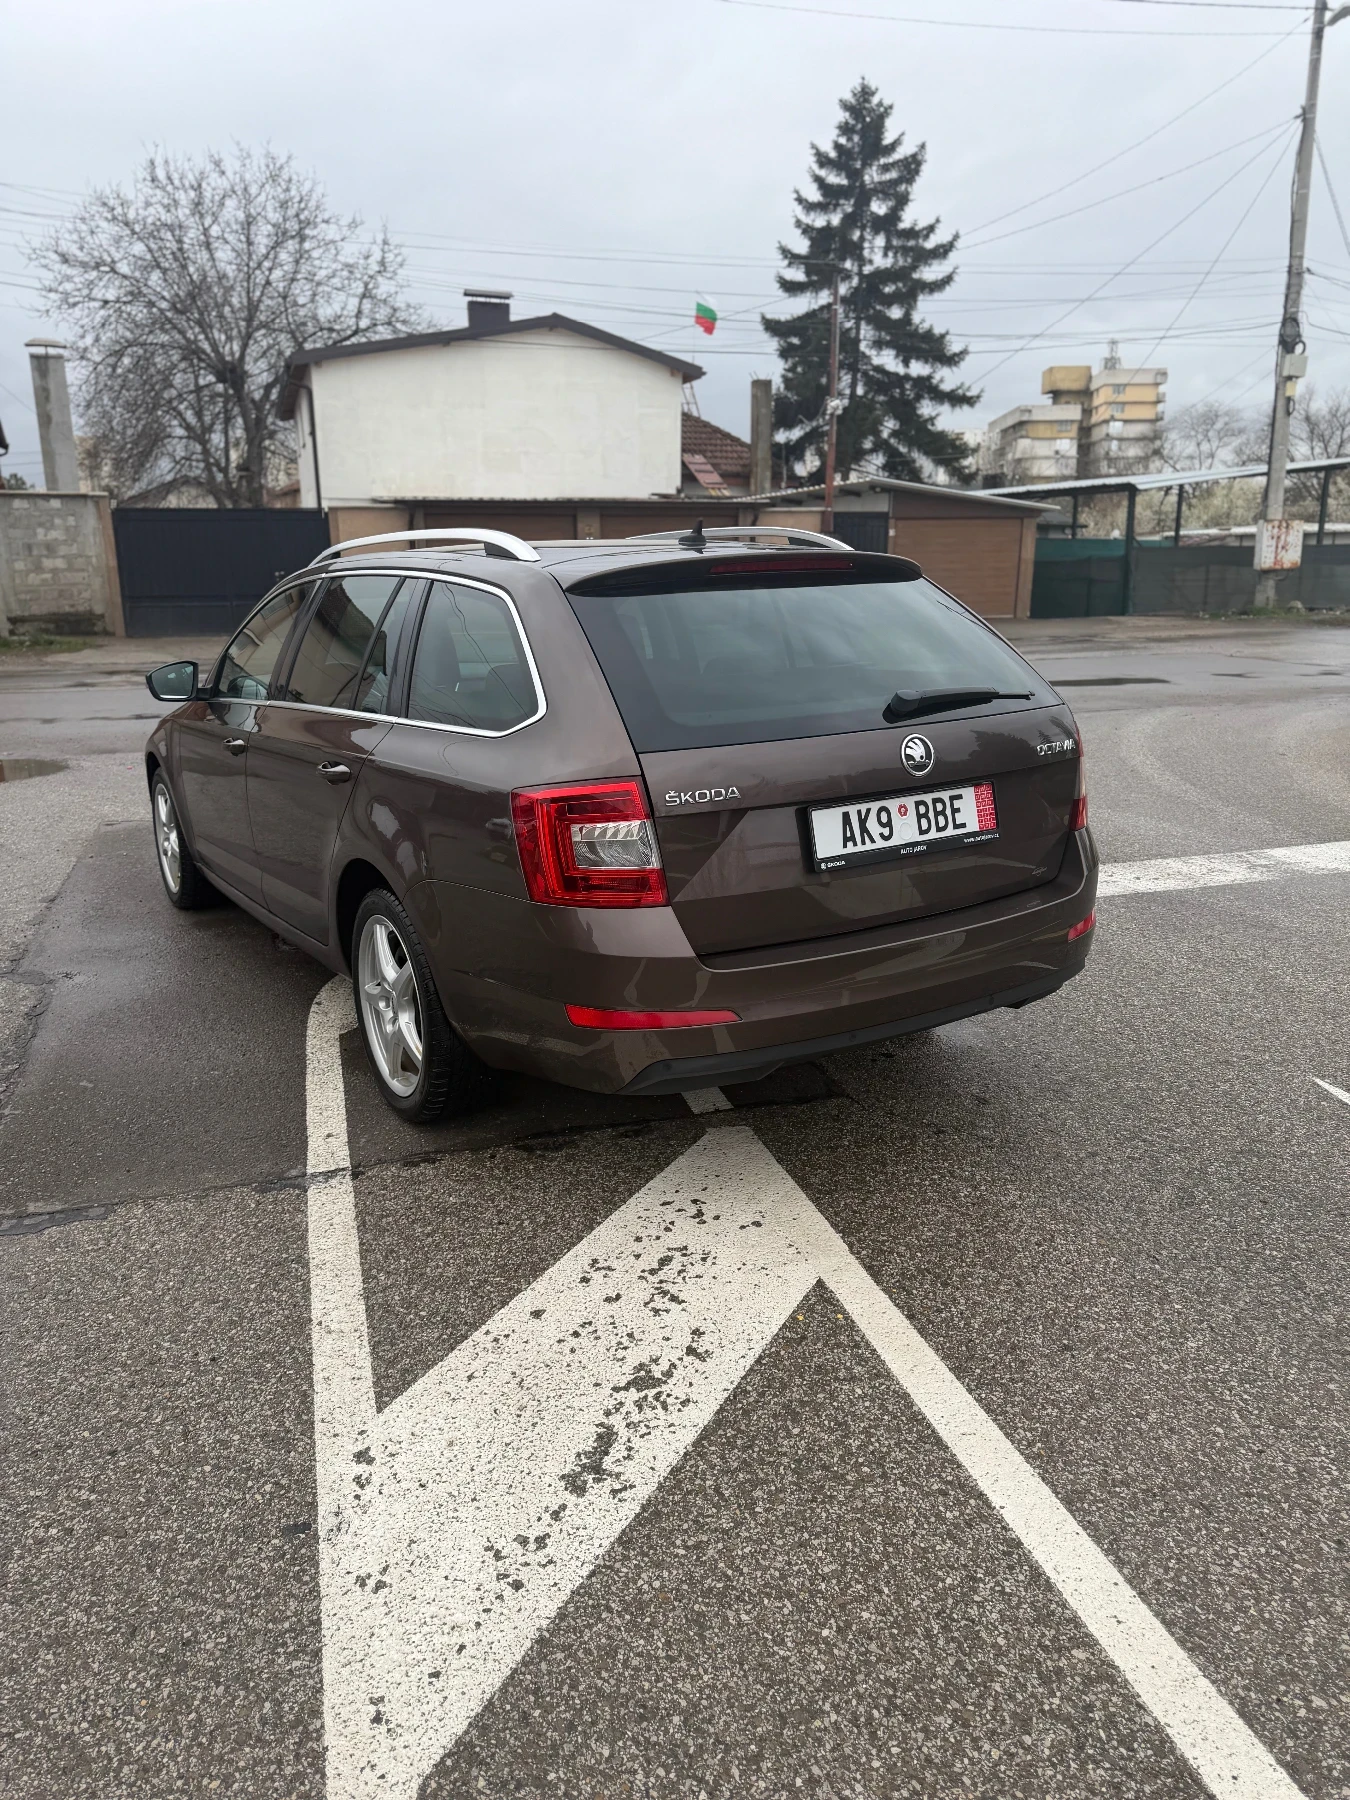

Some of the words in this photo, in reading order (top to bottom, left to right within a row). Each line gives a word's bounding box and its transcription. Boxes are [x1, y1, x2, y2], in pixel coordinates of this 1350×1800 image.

[1036, 739, 1076, 756] OCTAVIA
[665, 786, 741, 806] ŠKODA
[842, 805, 894, 849] AK9
[914, 793, 967, 836] BBE
